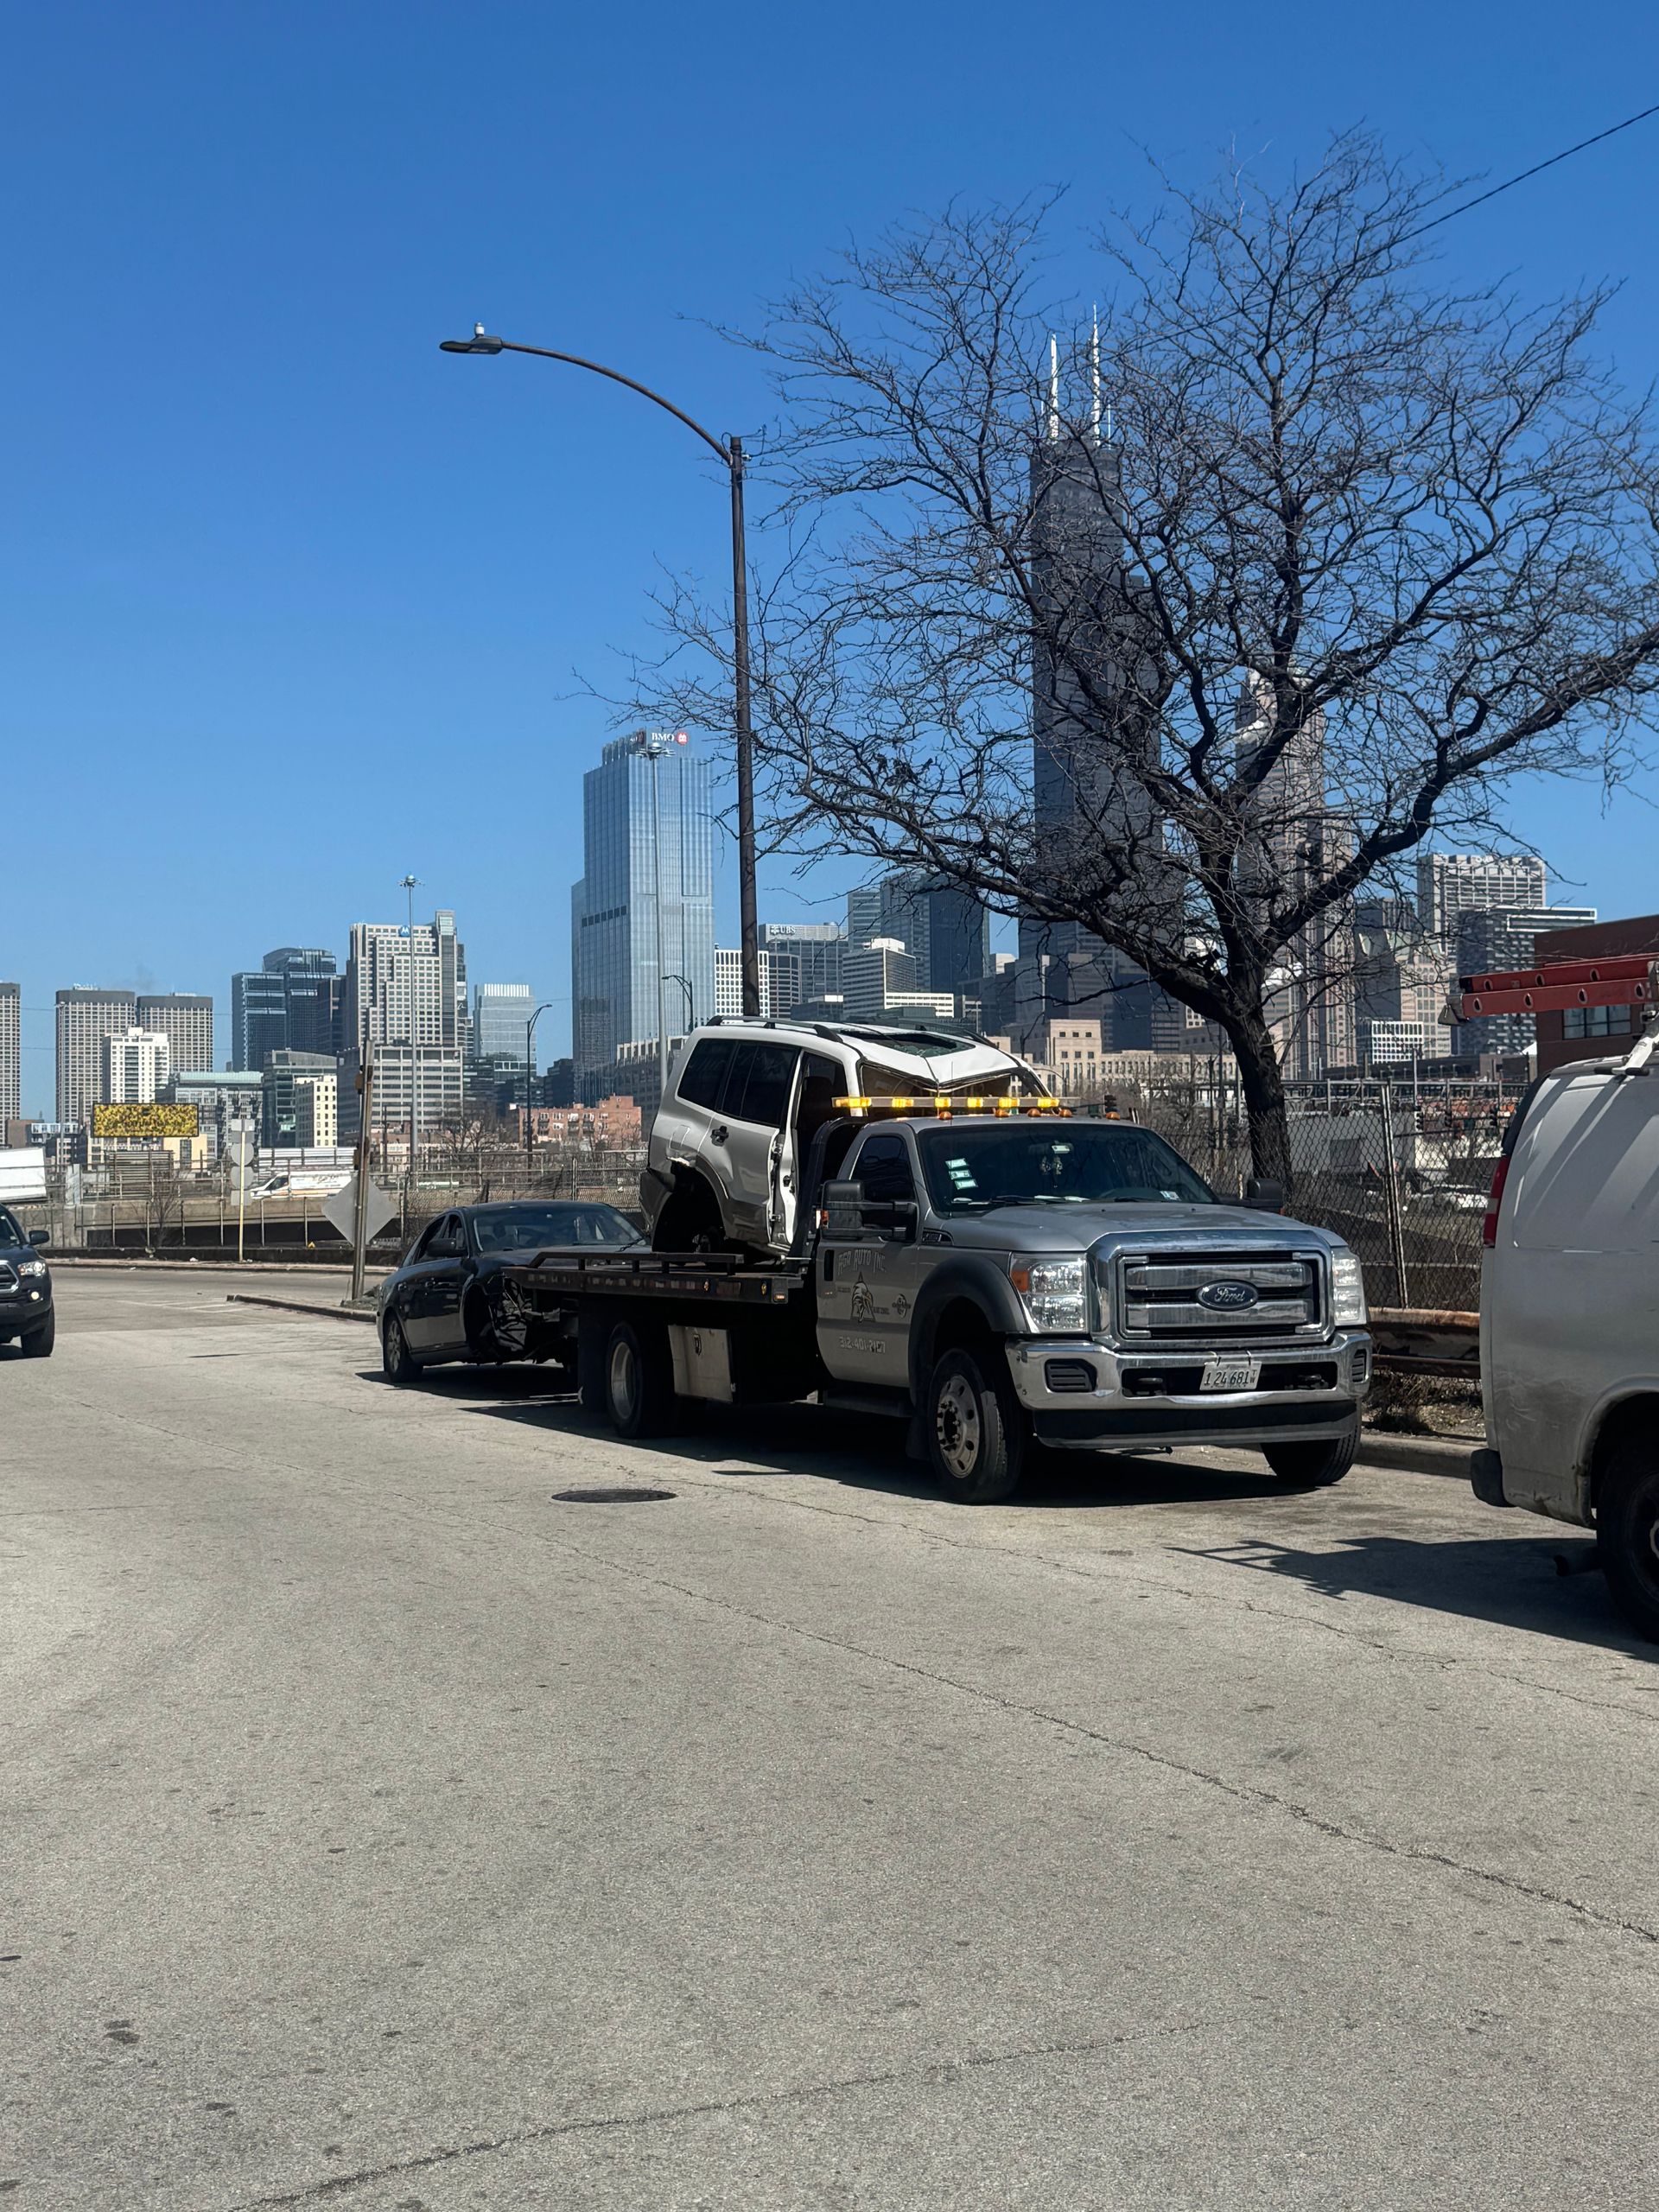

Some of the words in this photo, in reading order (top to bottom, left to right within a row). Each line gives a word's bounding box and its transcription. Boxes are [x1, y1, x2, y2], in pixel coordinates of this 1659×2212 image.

[652, 732, 675, 742] BMO
[853, 1249, 872, 1271] AUTO
[1214, 1287, 1246, 1302] Ford
